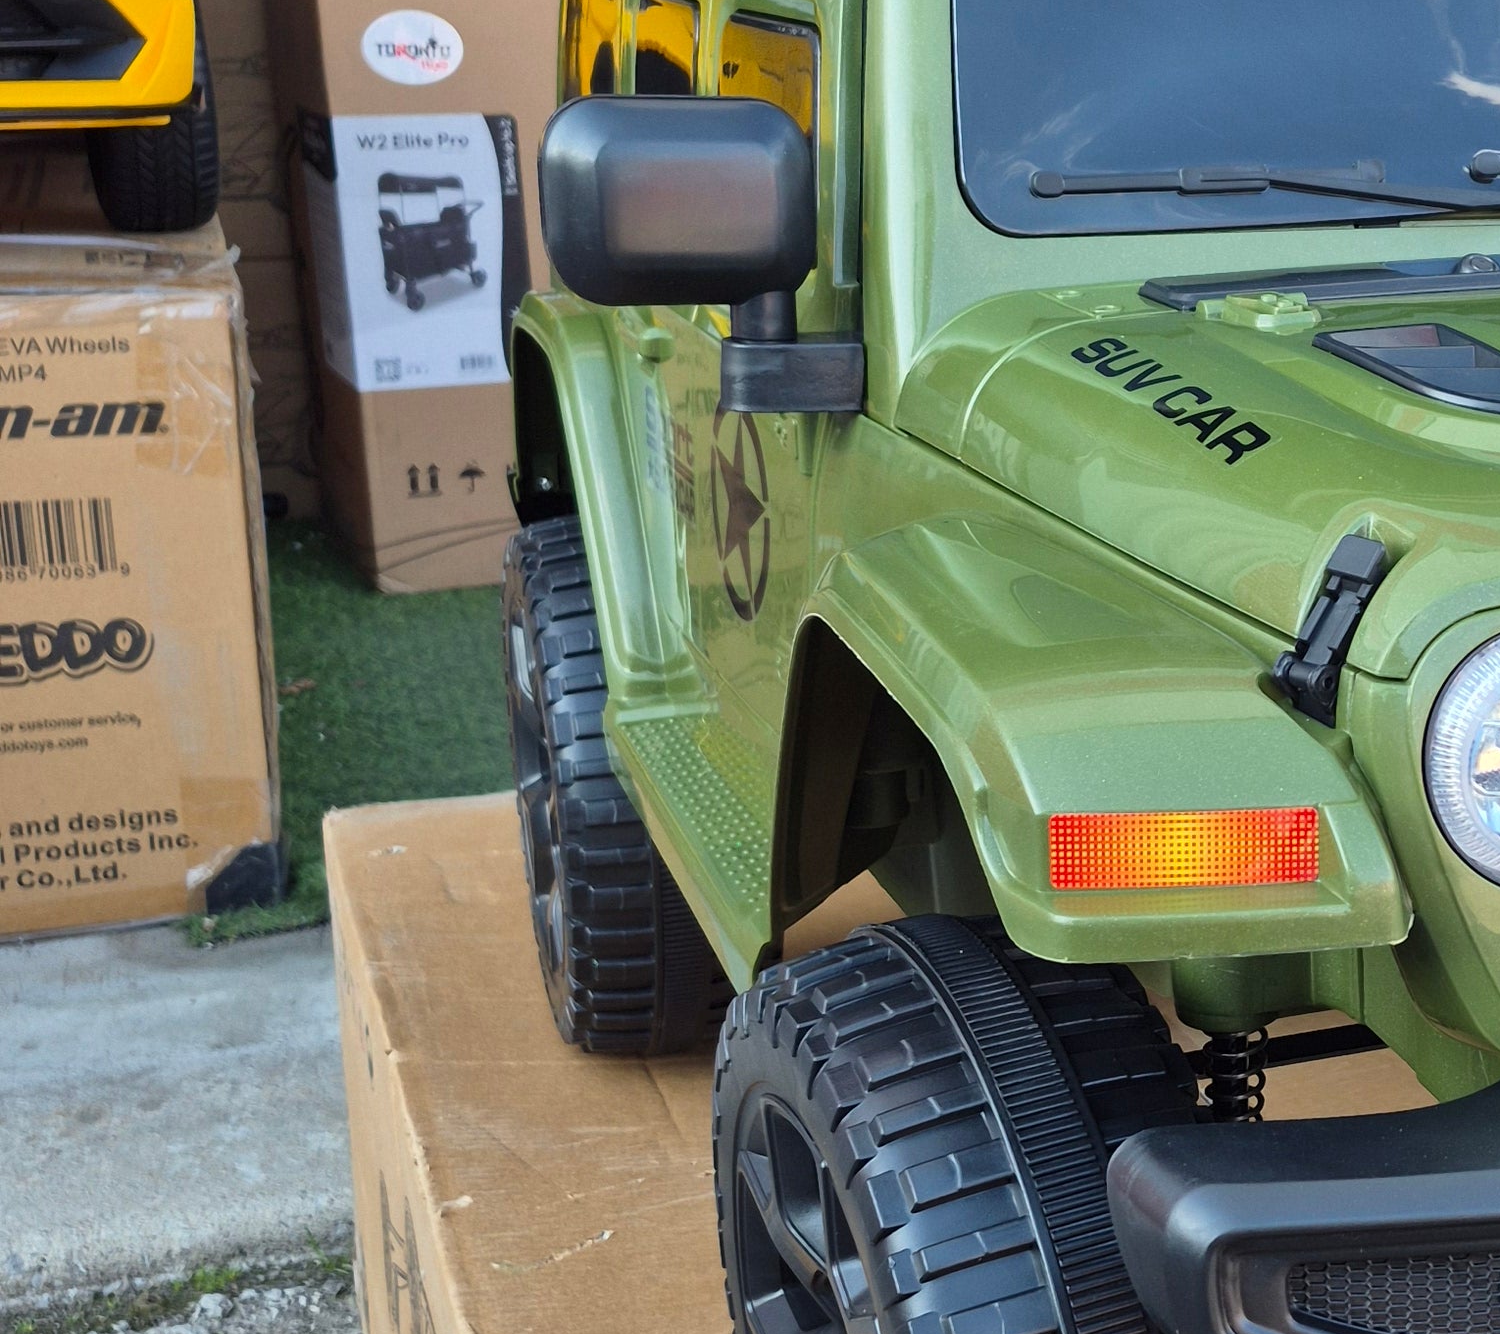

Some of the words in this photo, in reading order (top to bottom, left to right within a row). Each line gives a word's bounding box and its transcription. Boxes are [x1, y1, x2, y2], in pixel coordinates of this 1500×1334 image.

[357, 133, 388, 150] W2
[393, 132, 434, 150] Elite
[438, 132, 469, 149] Pro
[45, 335, 130, 355] Wheels
[0, 364, 46, 383] MP4
[1071, 337, 1183, 391] SUV
[1152, 386, 1271, 465] CAR
[18, 716, 84, 731] customer
[9, 814, 60, 837] and
[68, 809, 178, 831] designs
[14, 838, 142, 864] Products
[149, 832, 199, 851] Inc.
